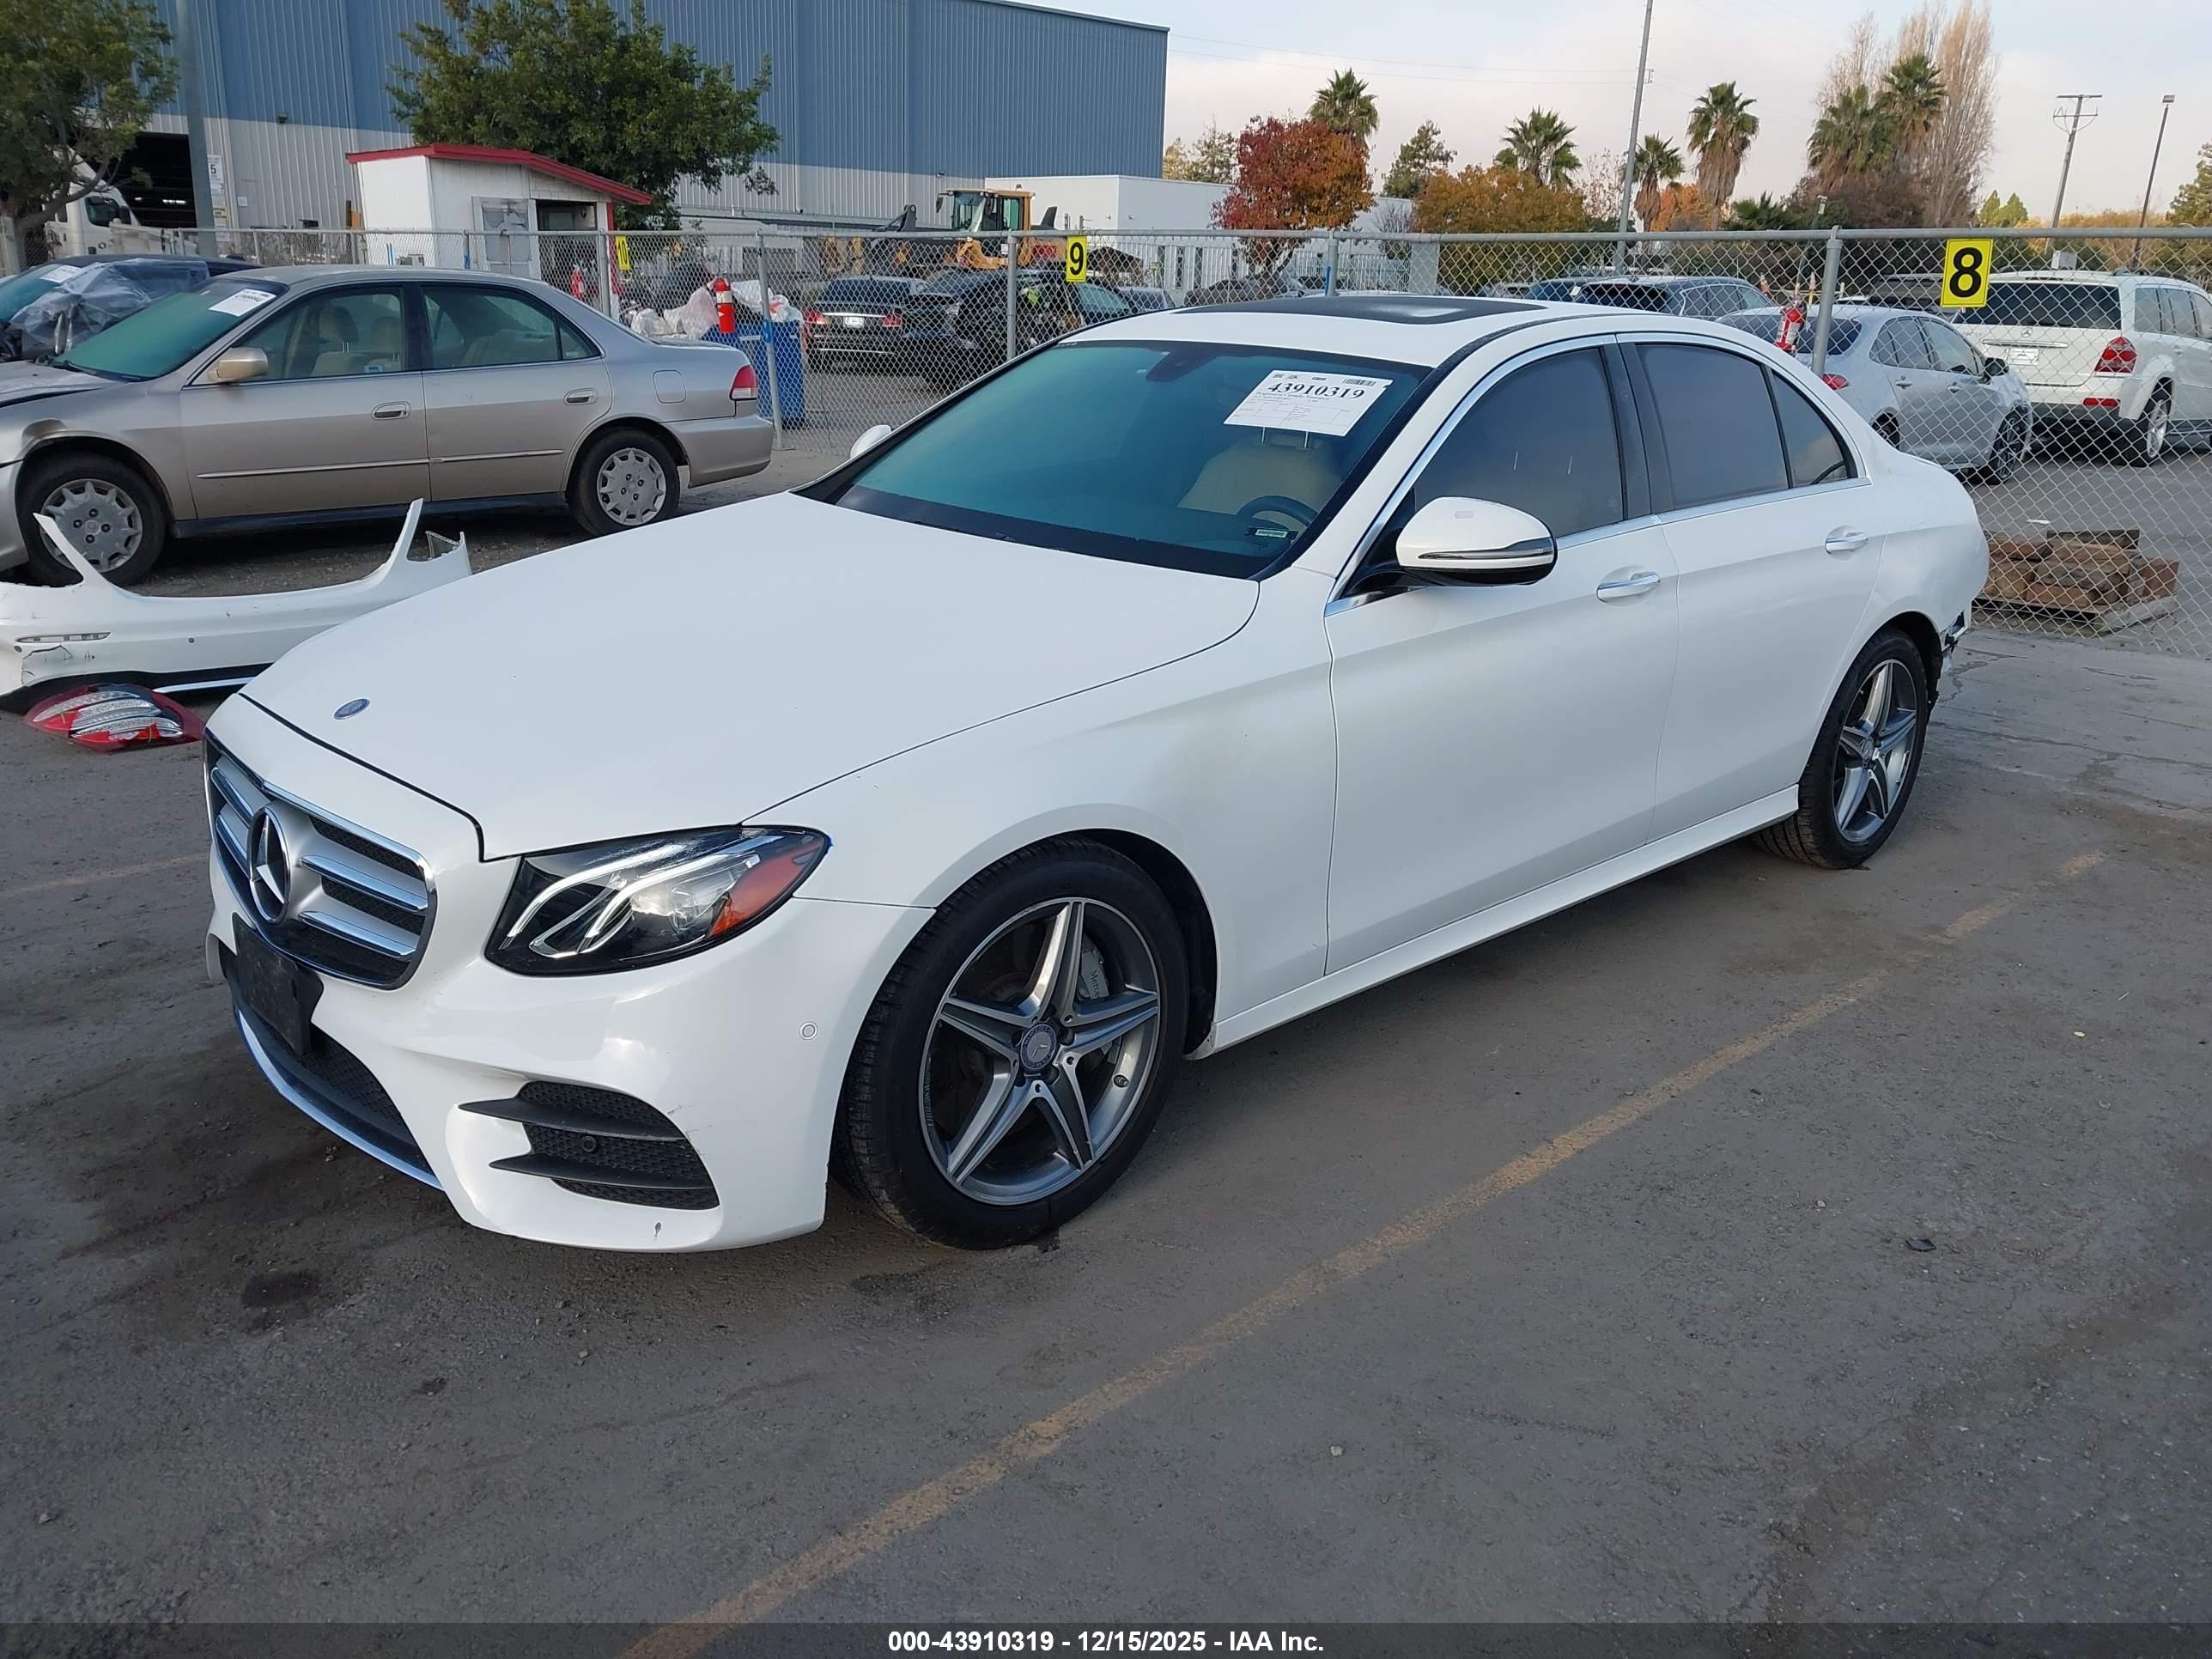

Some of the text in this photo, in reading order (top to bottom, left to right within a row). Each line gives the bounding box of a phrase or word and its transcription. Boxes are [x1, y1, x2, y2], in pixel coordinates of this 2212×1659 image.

[618, 240, 628, 264] 10
[1070, 242, 1084, 276] 9
[1949, 246, 1984, 298] 8
[1267, 382, 1365, 399] 43910319
